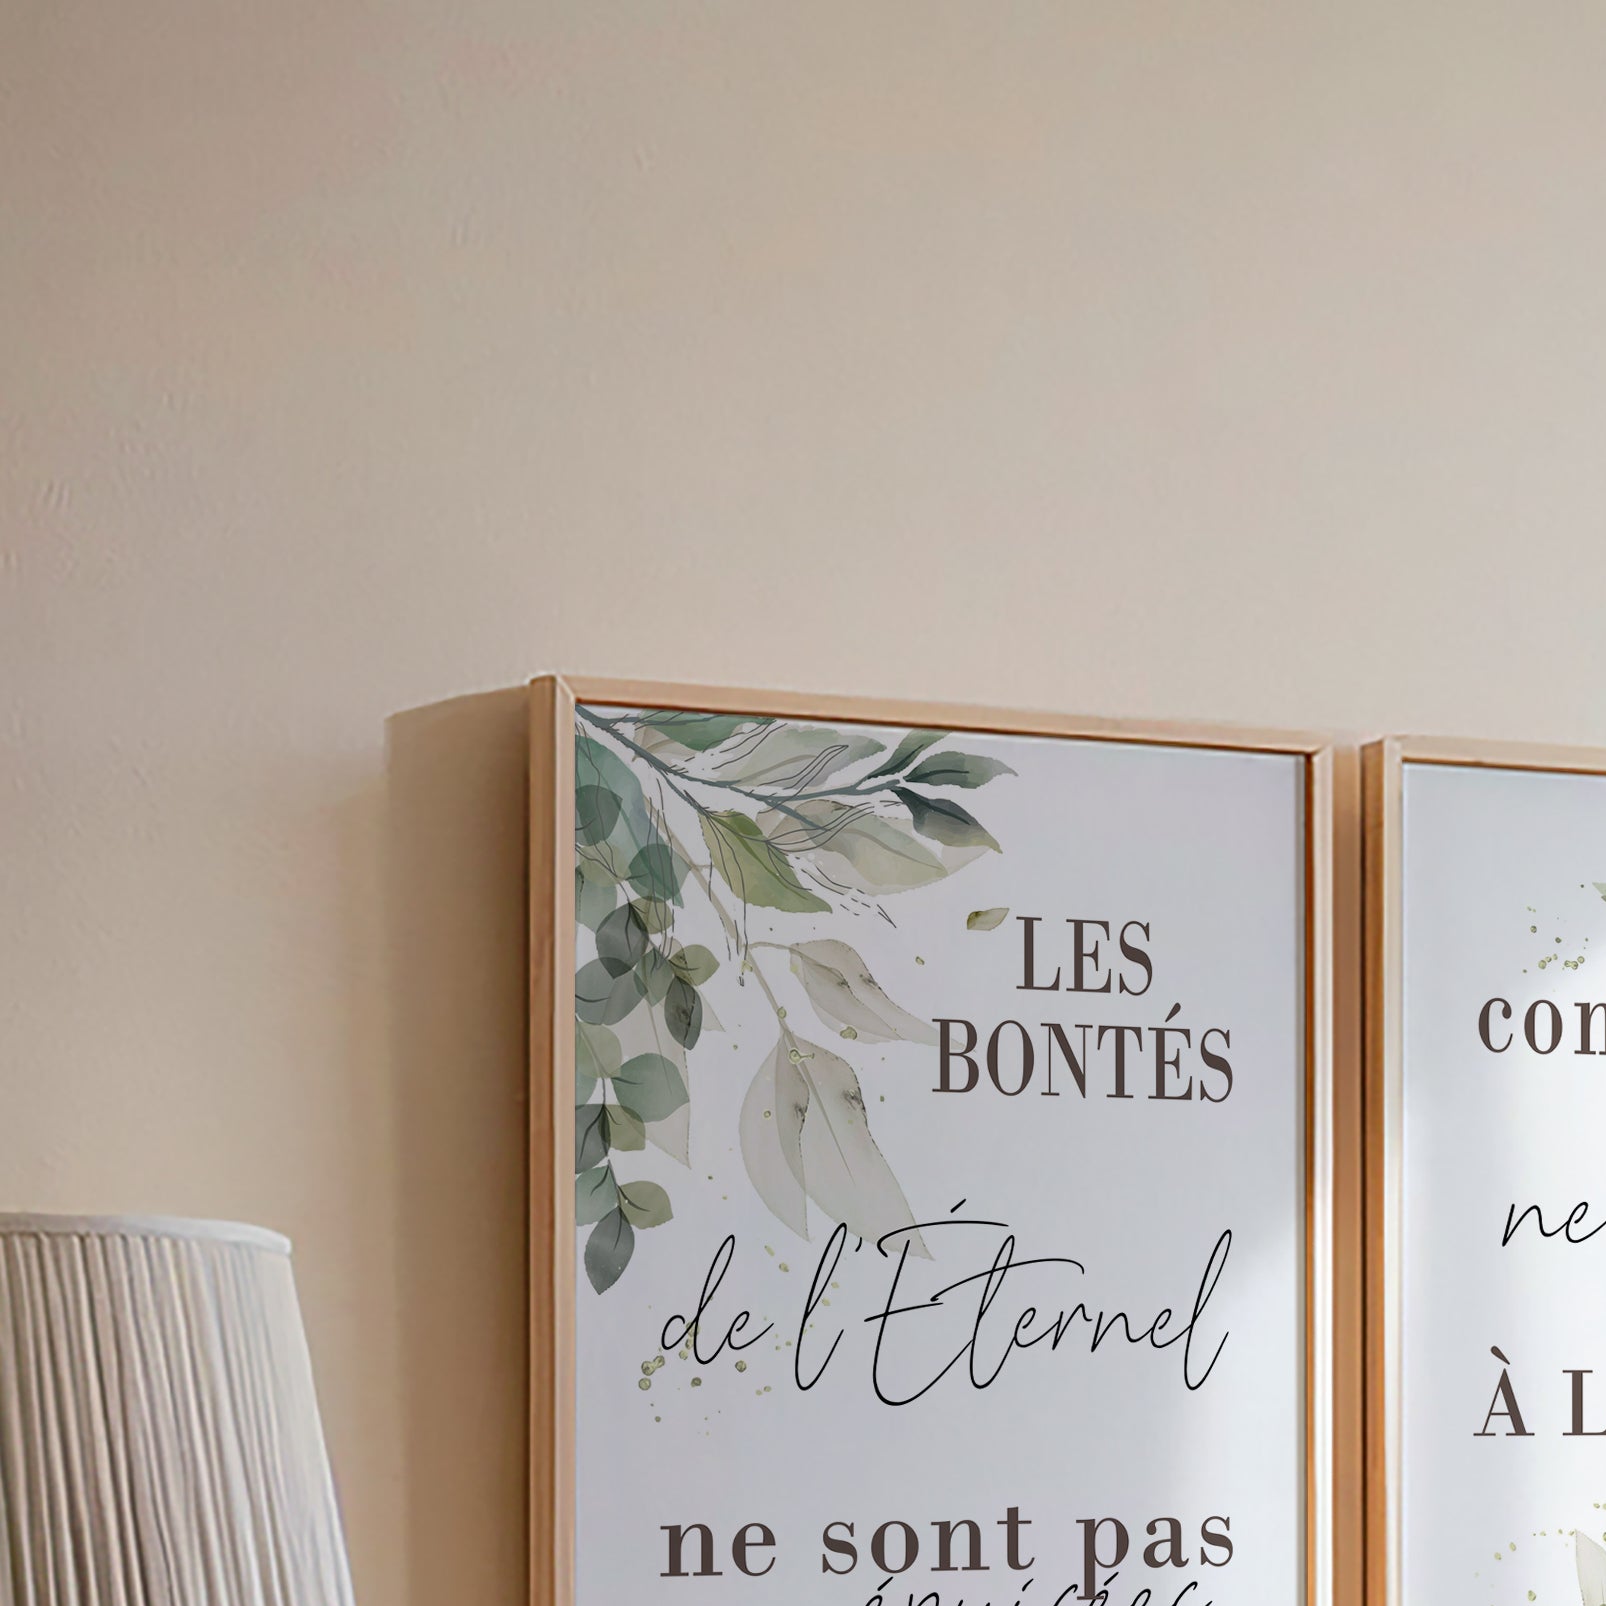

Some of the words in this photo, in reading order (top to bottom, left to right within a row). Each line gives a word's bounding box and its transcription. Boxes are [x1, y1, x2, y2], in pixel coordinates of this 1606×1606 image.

[1016, 917, 1153, 997] LES
[932, 1003, 1233, 1103] BONTÉS
[661, 1234, 774, 1365] de
[795, 1199, 1233, 1407] l'Éternel
[1473, 1345, 1535, 1437] À
[660, 1523, 777, 1578] ne
[822, 1506, 1036, 1575] sont
[1075, 1515, 1234, 1601] pas
